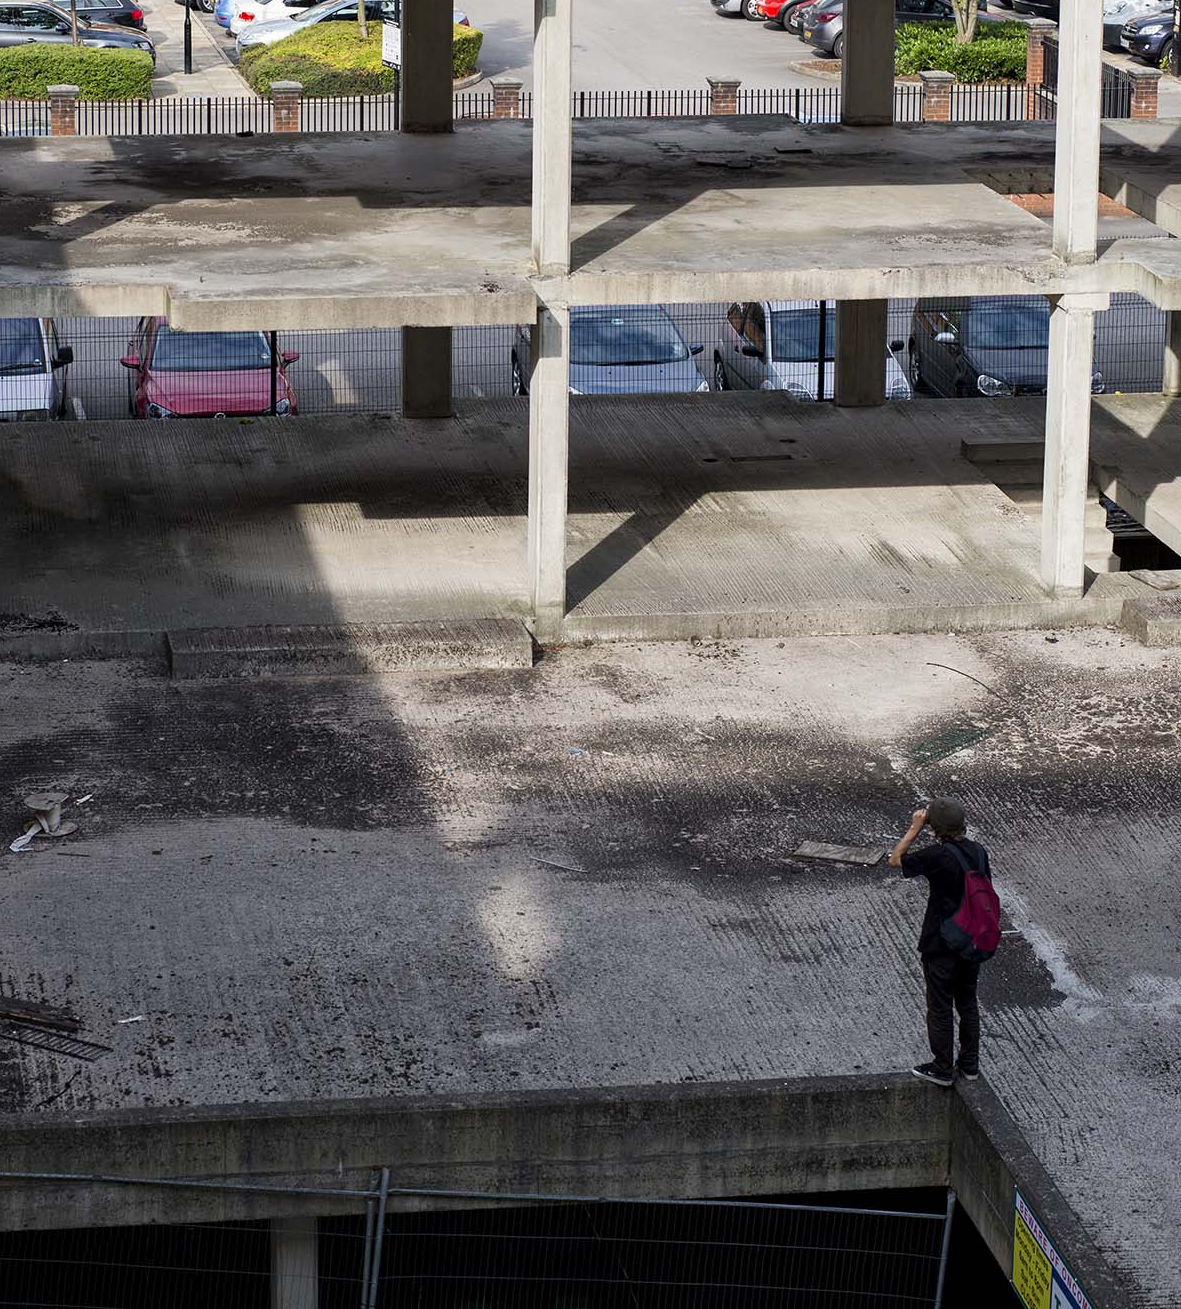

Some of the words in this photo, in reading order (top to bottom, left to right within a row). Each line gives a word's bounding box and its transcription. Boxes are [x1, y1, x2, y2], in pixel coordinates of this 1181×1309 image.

[1020, 1200, 1047, 1250] BEWARE
[1050, 1248, 1059, 1266] OF
[1062, 1267, 1090, 1309] ONCOM
